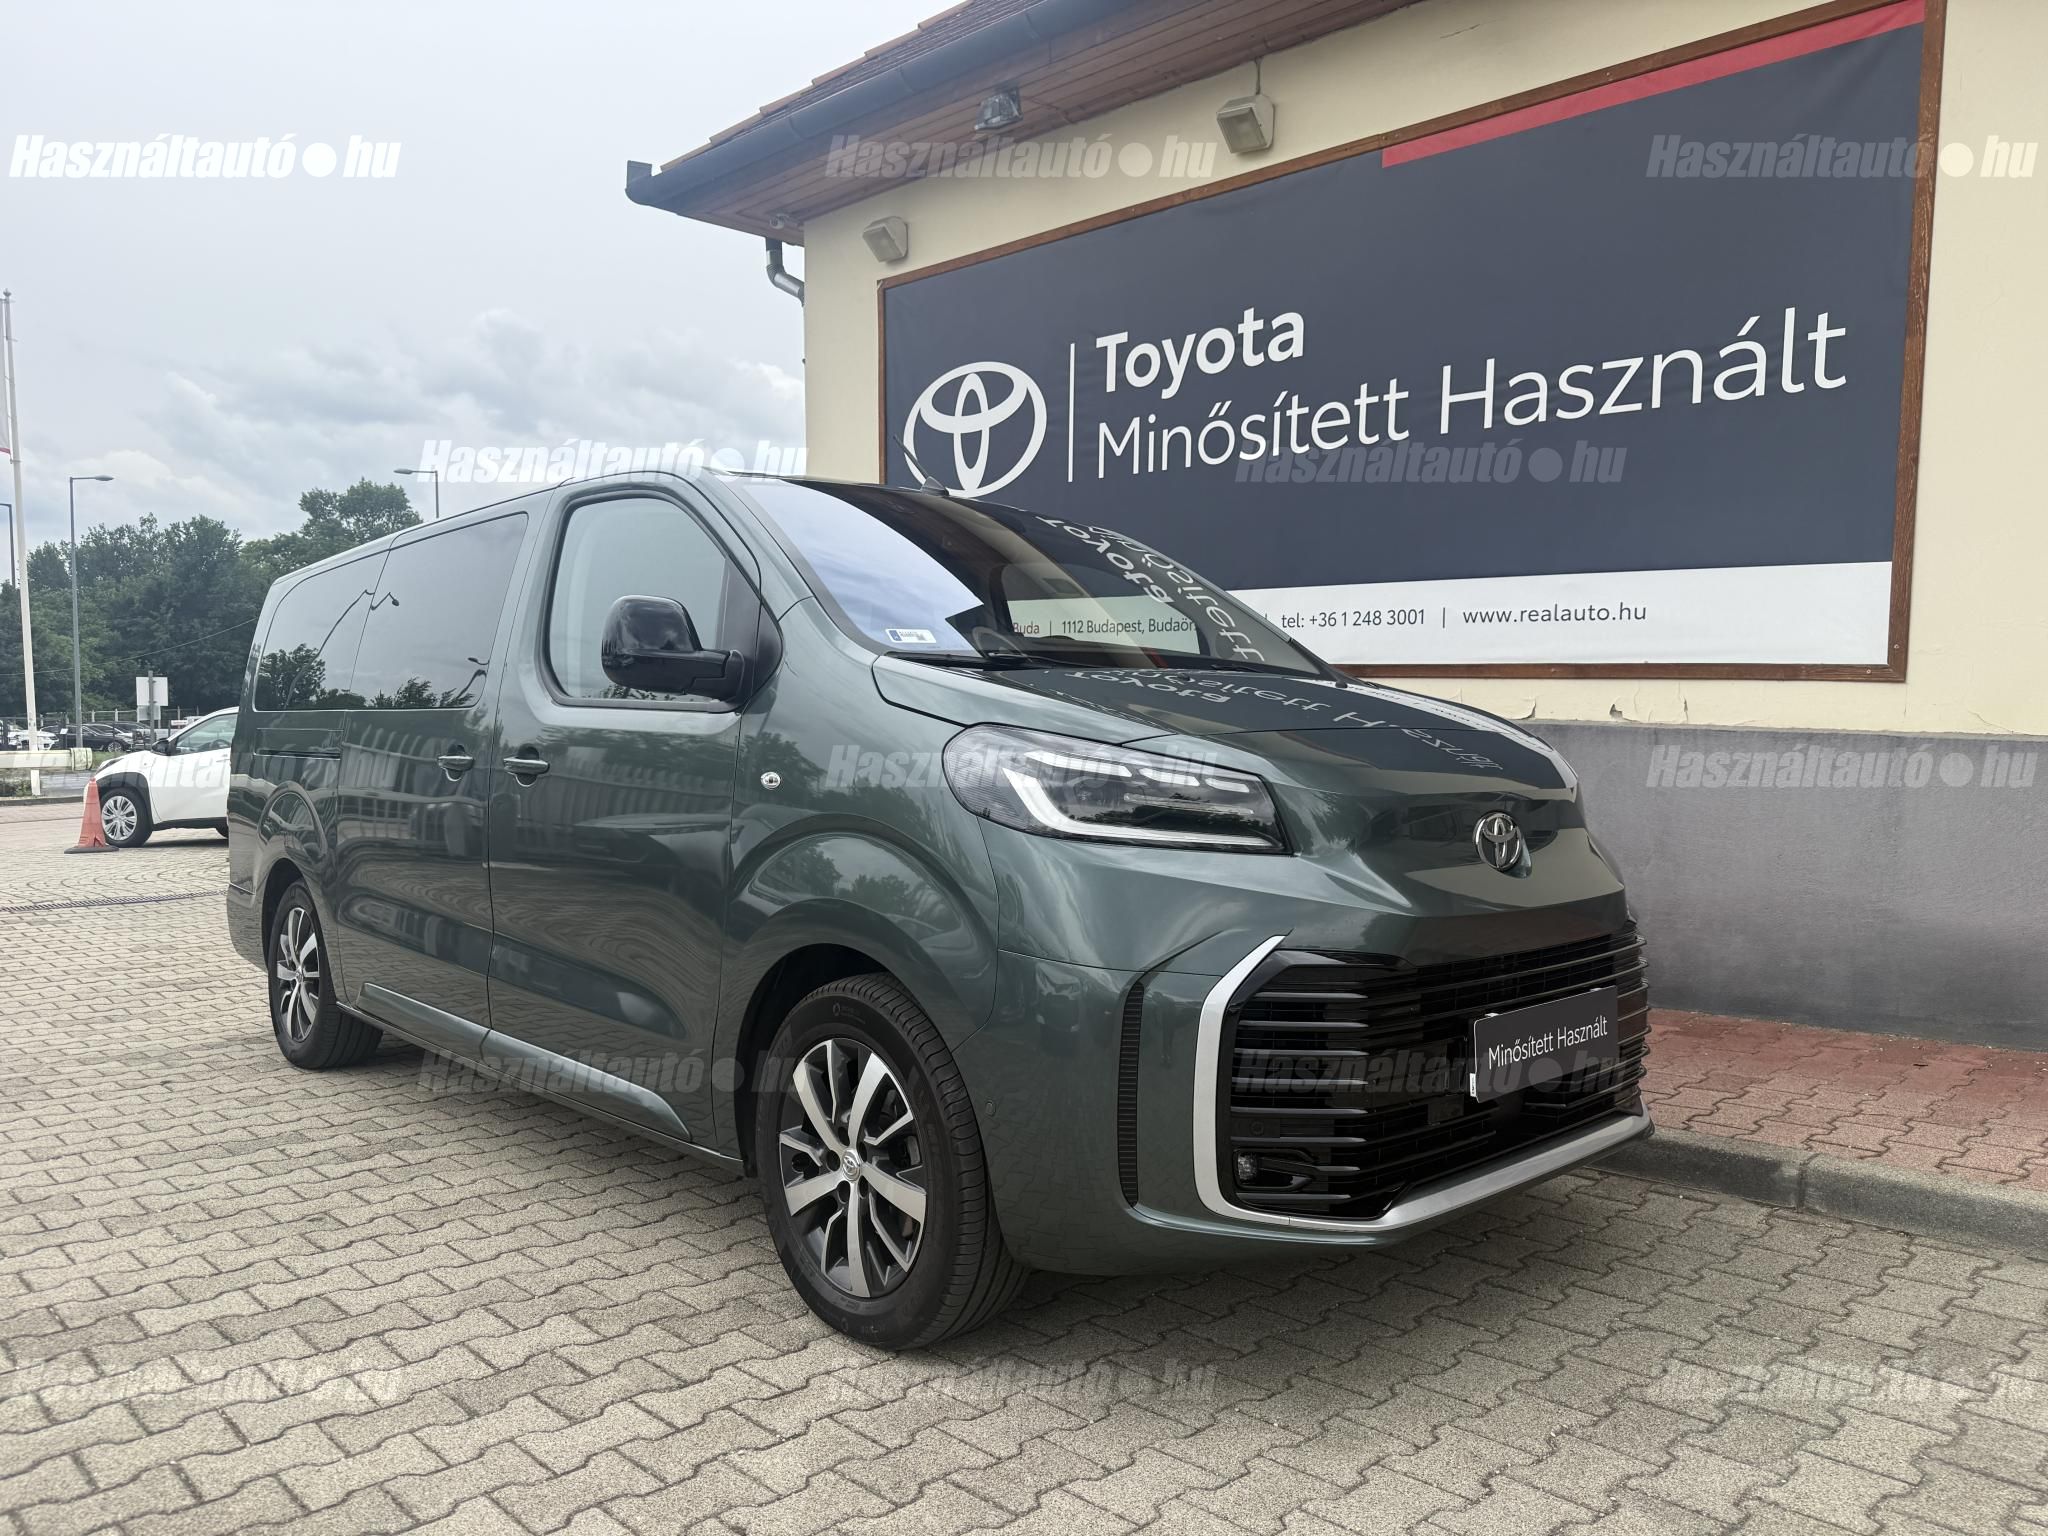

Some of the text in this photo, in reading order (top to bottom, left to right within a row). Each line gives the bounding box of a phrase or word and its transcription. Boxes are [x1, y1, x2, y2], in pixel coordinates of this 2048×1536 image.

[1096, 307, 1304, 399] Toyota
[1098, 307, 1846, 478] Minősített Használt
[1062, 620, 1084, 634] 1112
[1086, 618, 1145, 636] Budapest,
[1281, 613, 1304, 629] tel:
[1309, 611, 1337, 627] +36
[1341, 611, 1348, 627] 1
[1352, 610, 1382, 627] 248
[1386, 608, 1426, 626] 3001
[1463, 602, 1647, 624] www.realauto.hu
[1488, 1014, 1608, 1070] Minősített Használt
